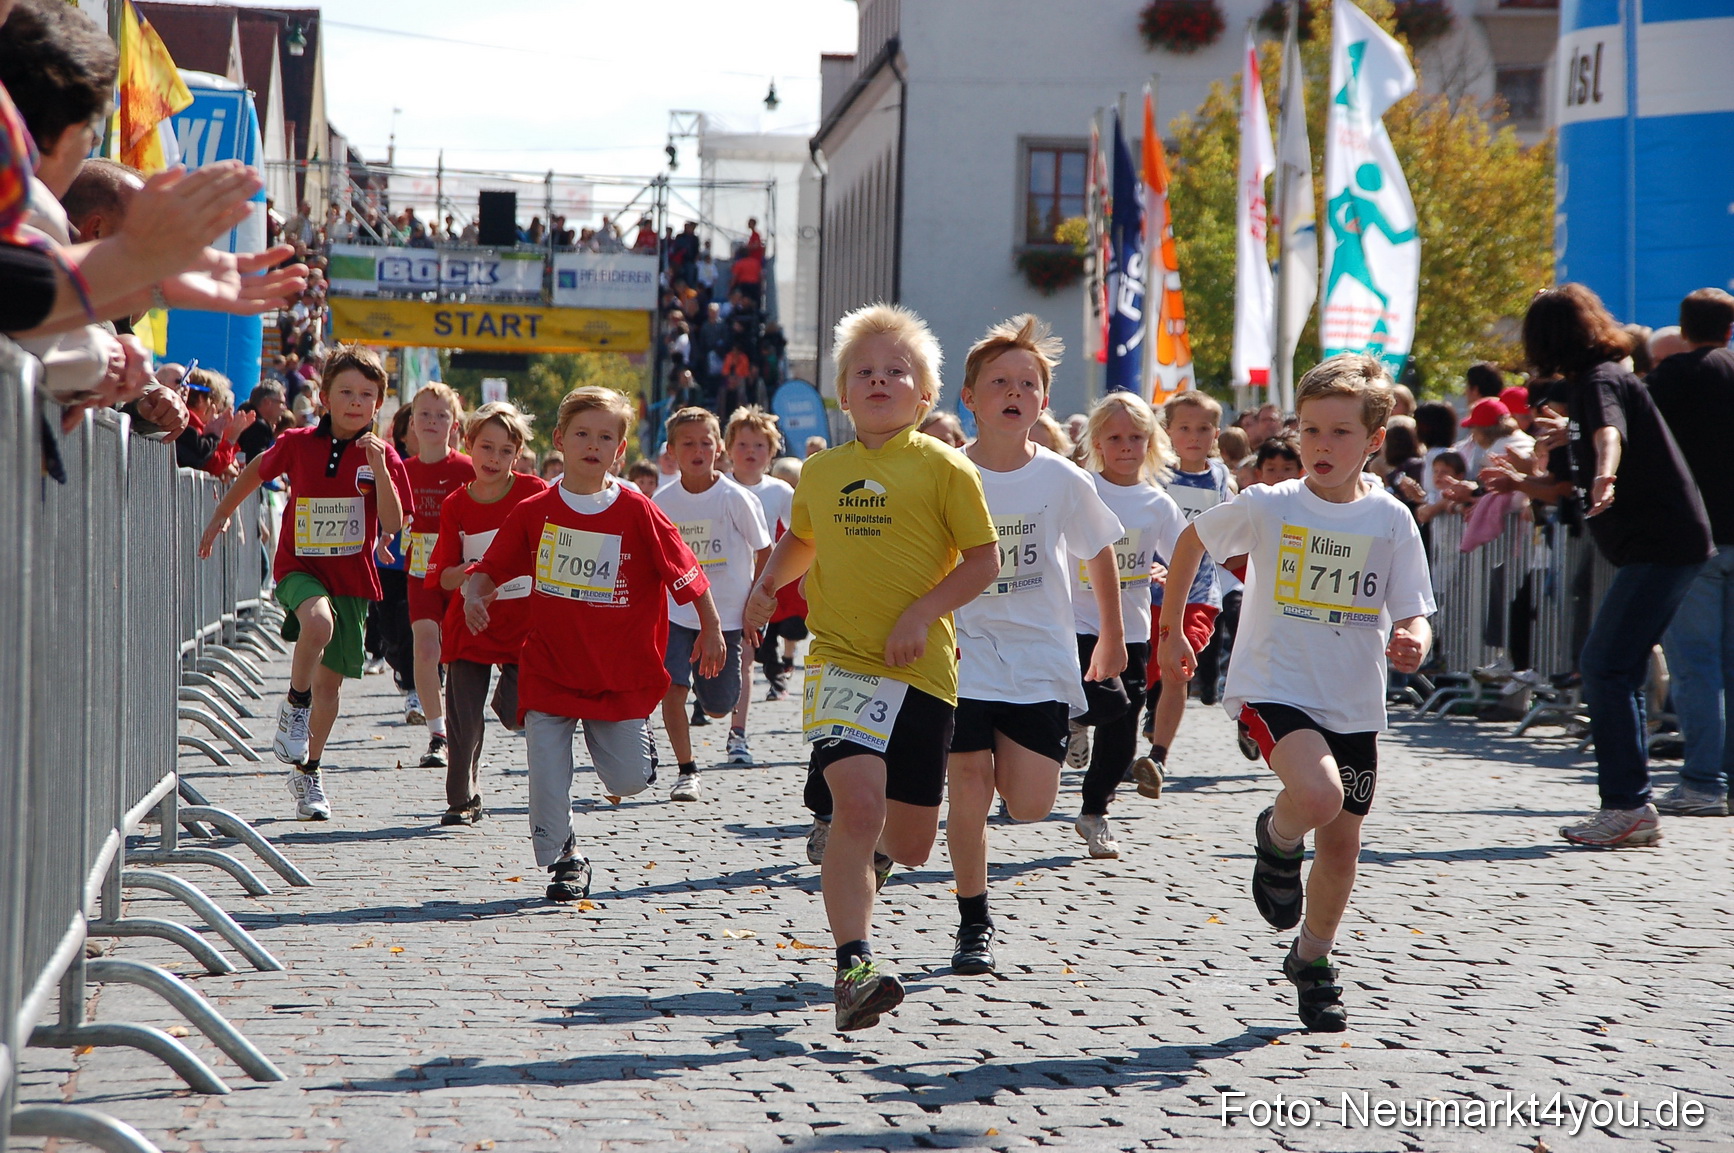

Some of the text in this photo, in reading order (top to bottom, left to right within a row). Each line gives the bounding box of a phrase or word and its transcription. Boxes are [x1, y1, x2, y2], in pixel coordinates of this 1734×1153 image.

[378, 257, 500, 285] BOCK
[433, 311, 543, 338] START
[838, 496, 886, 507] skinfit
[312, 502, 356, 514] Jonathan
[297, 519, 306, 528] K4
[833, 513, 892, 524] TV Hilpoltstein
[314, 519, 360, 536] 7278
[679, 525, 704, 535] Moritz
[844, 527, 881, 536] Triathlon
[558, 532, 572, 547] Uli
[1311, 535, 1352, 558] Kilian
[539, 548, 549, 560] K4
[558, 553, 611, 579] 7094
[1282, 559, 1296, 574] K4
[1009, 577, 1043, 588] PFLEIDERER
[1310, 565, 1378, 598] 7116
[580, 589, 612, 599] PFLEIDERER
[1283, 605, 1313, 616] BOCK
[1342, 612, 1379, 623] PFLEIDERER
[821, 686, 889, 723] 7273
[844, 726, 886, 747] PFLEIDERER
